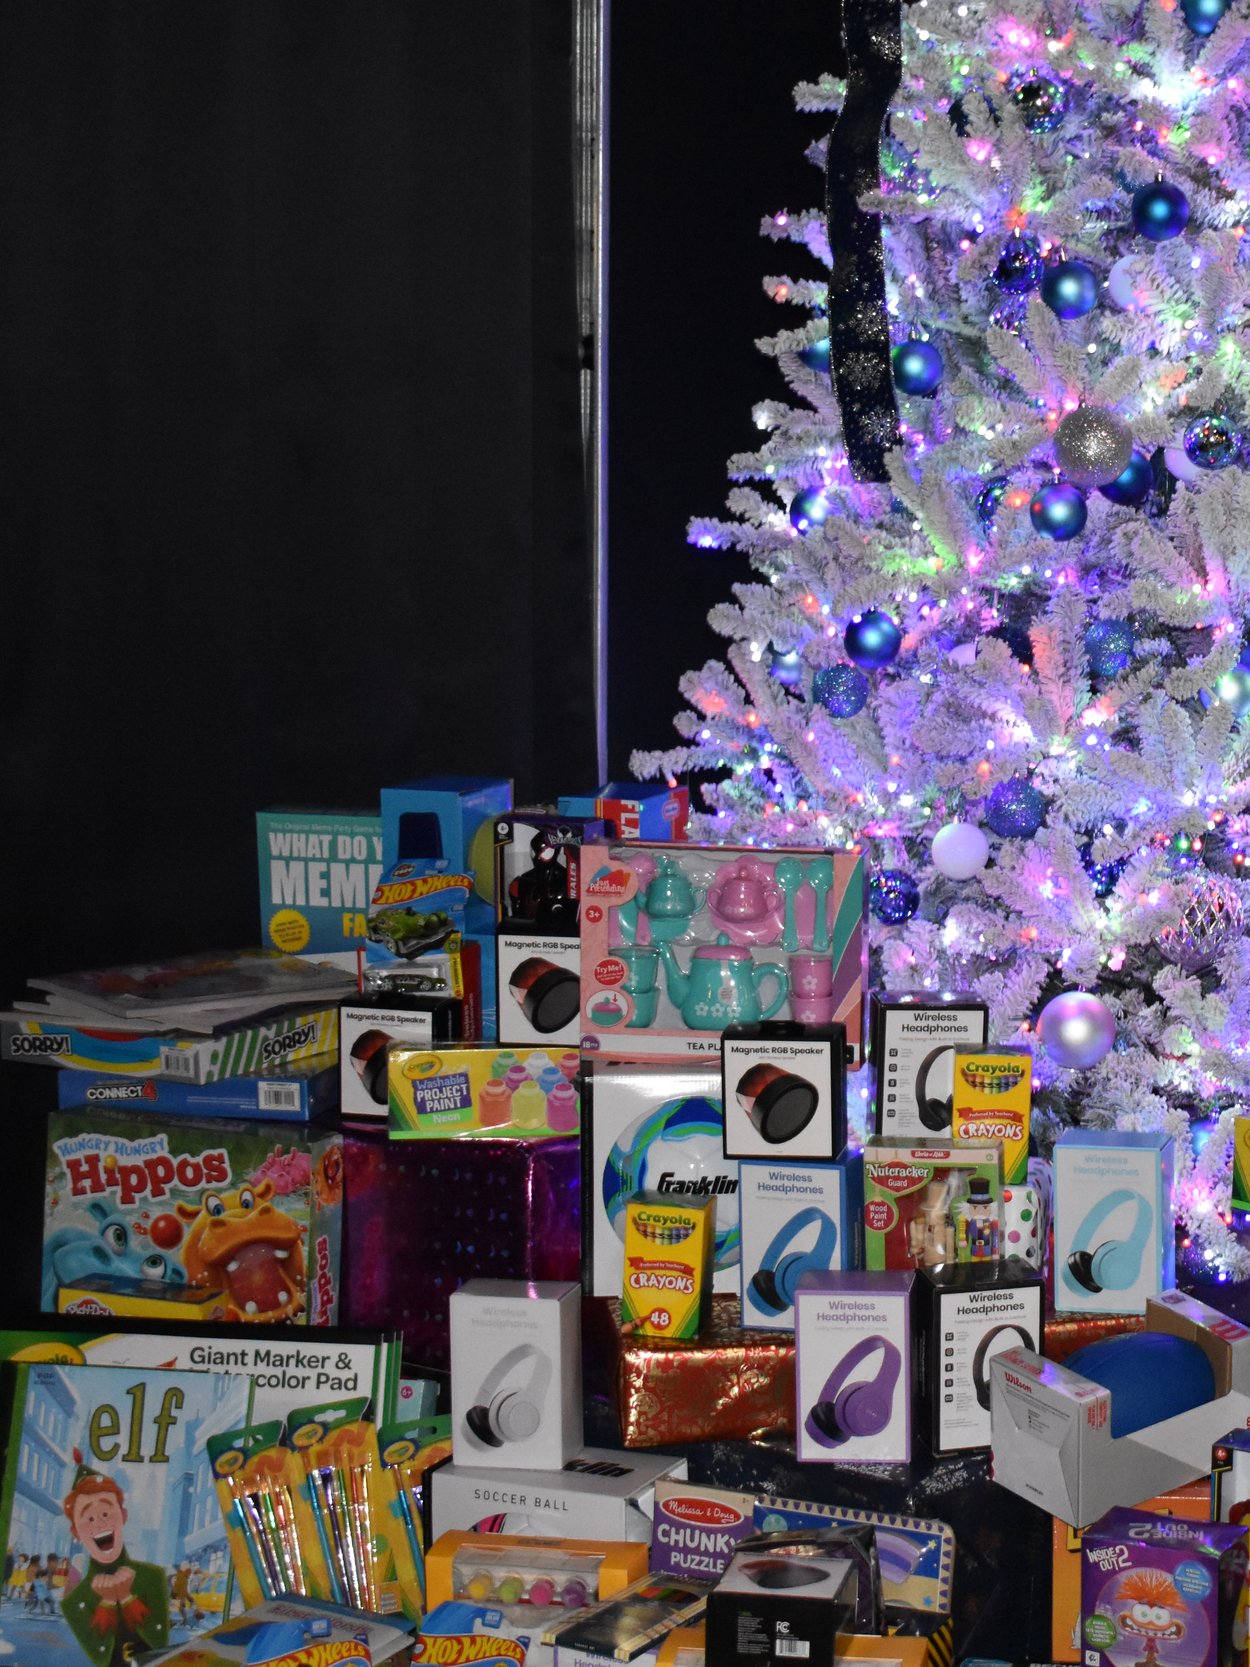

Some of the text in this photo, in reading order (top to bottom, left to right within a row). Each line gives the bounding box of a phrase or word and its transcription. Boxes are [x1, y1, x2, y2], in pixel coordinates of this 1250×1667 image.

[269, 832, 333, 859] WHAT
[337, 835, 368, 860] DO
[588, 910, 600, 918] 3+
[505, 939, 541, 951] Magnetic
[542, 941, 558, 949] RGB
[596, 964, 622, 974] Try Me!
[346, 1012, 427, 1025] Magnetic RGB Speaker
[913, 1012, 958, 1023] Wireless
[901, 1023, 969, 1035] Headphones
[10, 1034, 72, 1055] SORRY!
[263, 1022, 317, 1061] SORRY!
[687, 1042, 705, 1051] TEA
[731, 1045, 825, 1057] Magnetic RGB Speaker
[965, 1061, 1022, 1077] Crayola
[417, 1075, 466, 1090] Washable
[86, 1086, 143, 1099] CONNECT
[416, 1084, 468, 1102] PROJECT
[426, 1097, 462, 1113] PAINT
[433, 1112, 461, 1124] Neon
[958, 1122, 1023, 1141] CRAYONS
[57, 1136, 166, 1157] HUNGRY HUNGRY
[1084, 1155, 1129, 1165] Wireless
[65, 1150, 229, 1205] Hippos
[768, 1171, 813, 1182] Wireless
[866, 1163, 929, 1179] Nutcracker
[1073, 1166, 1140, 1177] Headphones
[757, 1182, 825, 1195] Headphones
[888, 1178, 908, 1188] Guard
[868, 1203, 888, 1213] Wood
[637, 1210, 694, 1226] Crayola
[869, 1212, 887, 1221] Paint
[873, 1220, 884, 1228] Set
[629, 1272, 694, 1293] CRAYONS
[968, 1291, 1015, 1303] Wireless
[827, 1300, 876, 1311] Wireless
[956, 1302, 1025, 1315] Headphones
[650, 1311, 670, 1326] 48
[816, 1312, 888, 1325] Headphones
[189, 1346, 353, 1371] Giant Marker &
[316, 1372, 358, 1392] Pad
[1004, 1371, 1032, 1393] Wilson
[89, 1381, 186, 1464] elf
[474, 1488, 569, 1512] SOCCER BALL
[668, 1499, 704, 1516] Melissa
[713, 1507, 737, 1524] Doug
[1128, 1522, 1204, 1541] INSIDE 2
[1155, 1521, 1188, 1531] OUT
[671, 1552, 725, 1573] PUZZLE
[1086, 1545, 1132, 1568] INSIDE 2
[1099, 1557, 1119, 1571] OUT
